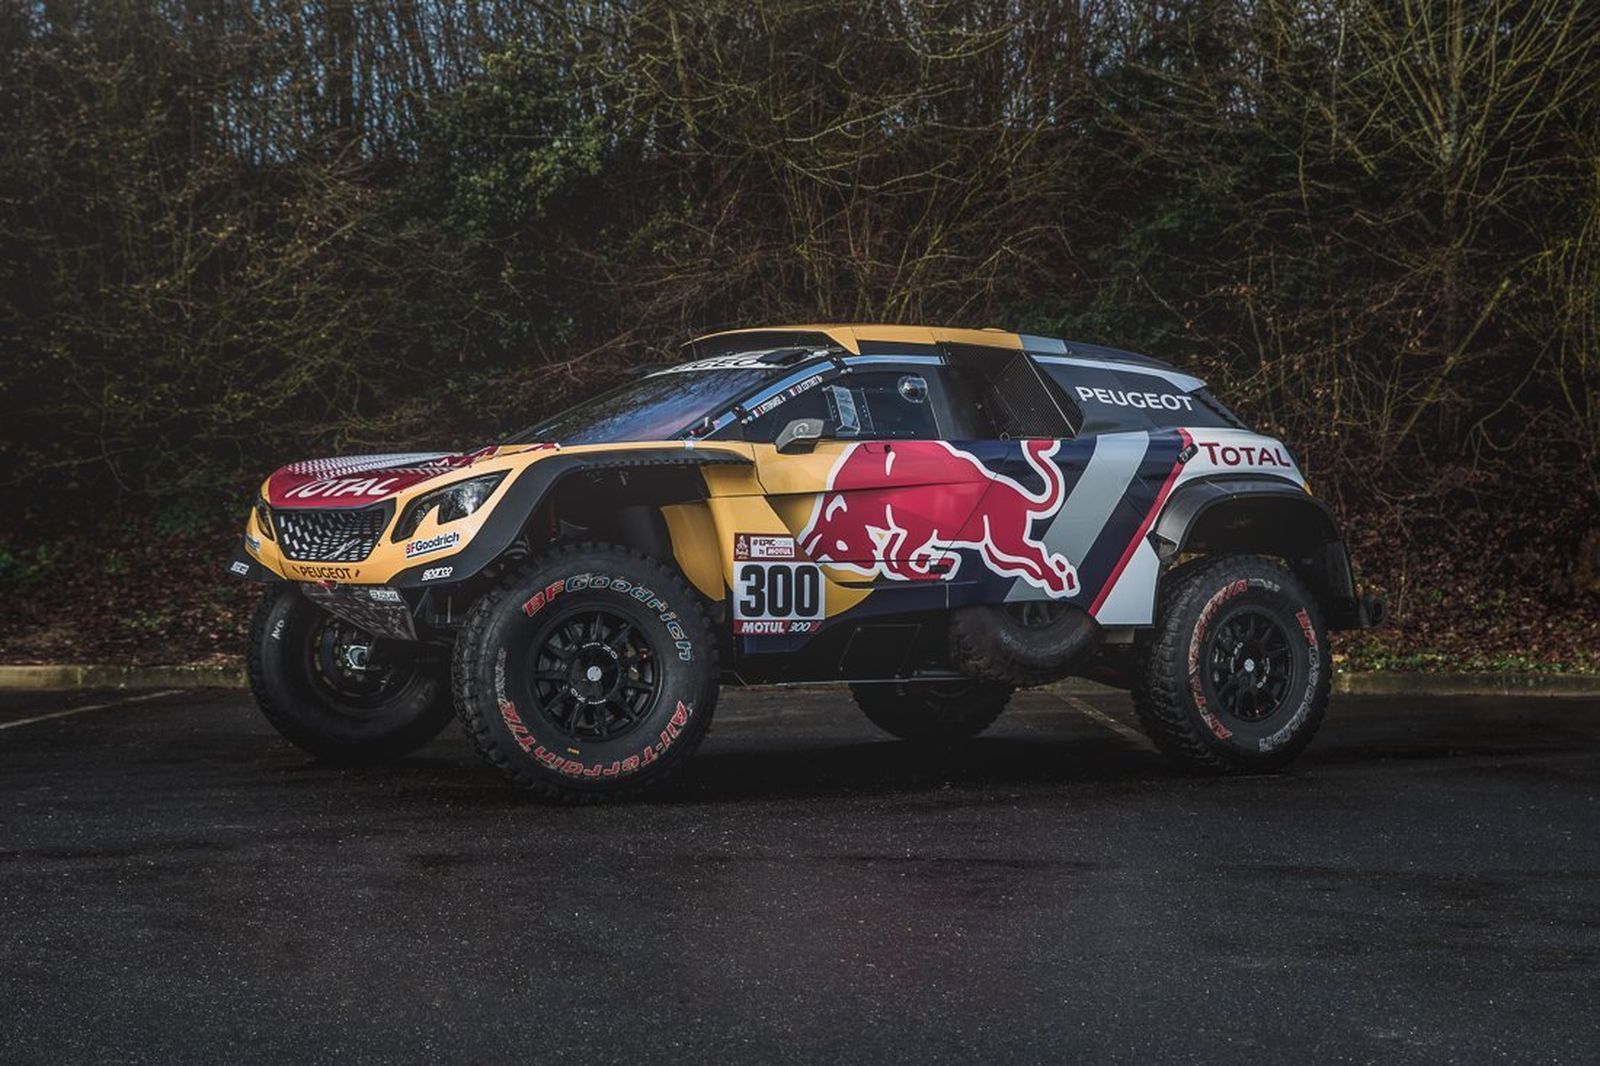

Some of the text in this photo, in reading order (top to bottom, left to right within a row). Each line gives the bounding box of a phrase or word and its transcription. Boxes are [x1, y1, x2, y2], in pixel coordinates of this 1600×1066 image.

[1075, 386, 1192, 411] PEUGEOT
[1199, 442, 1291, 467] TOTAL
[284, 477, 399, 499] TOTAL
[406, 532, 460, 555] BFGoodrich
[299, 566, 352, 580] PEUGEOT
[740, 565, 820, 617] 300
[522, 573, 692, 662] BFGoodrich
[741, 622, 785, 633] MOTUL
[533, 700, 689, 778] All-Terrain
